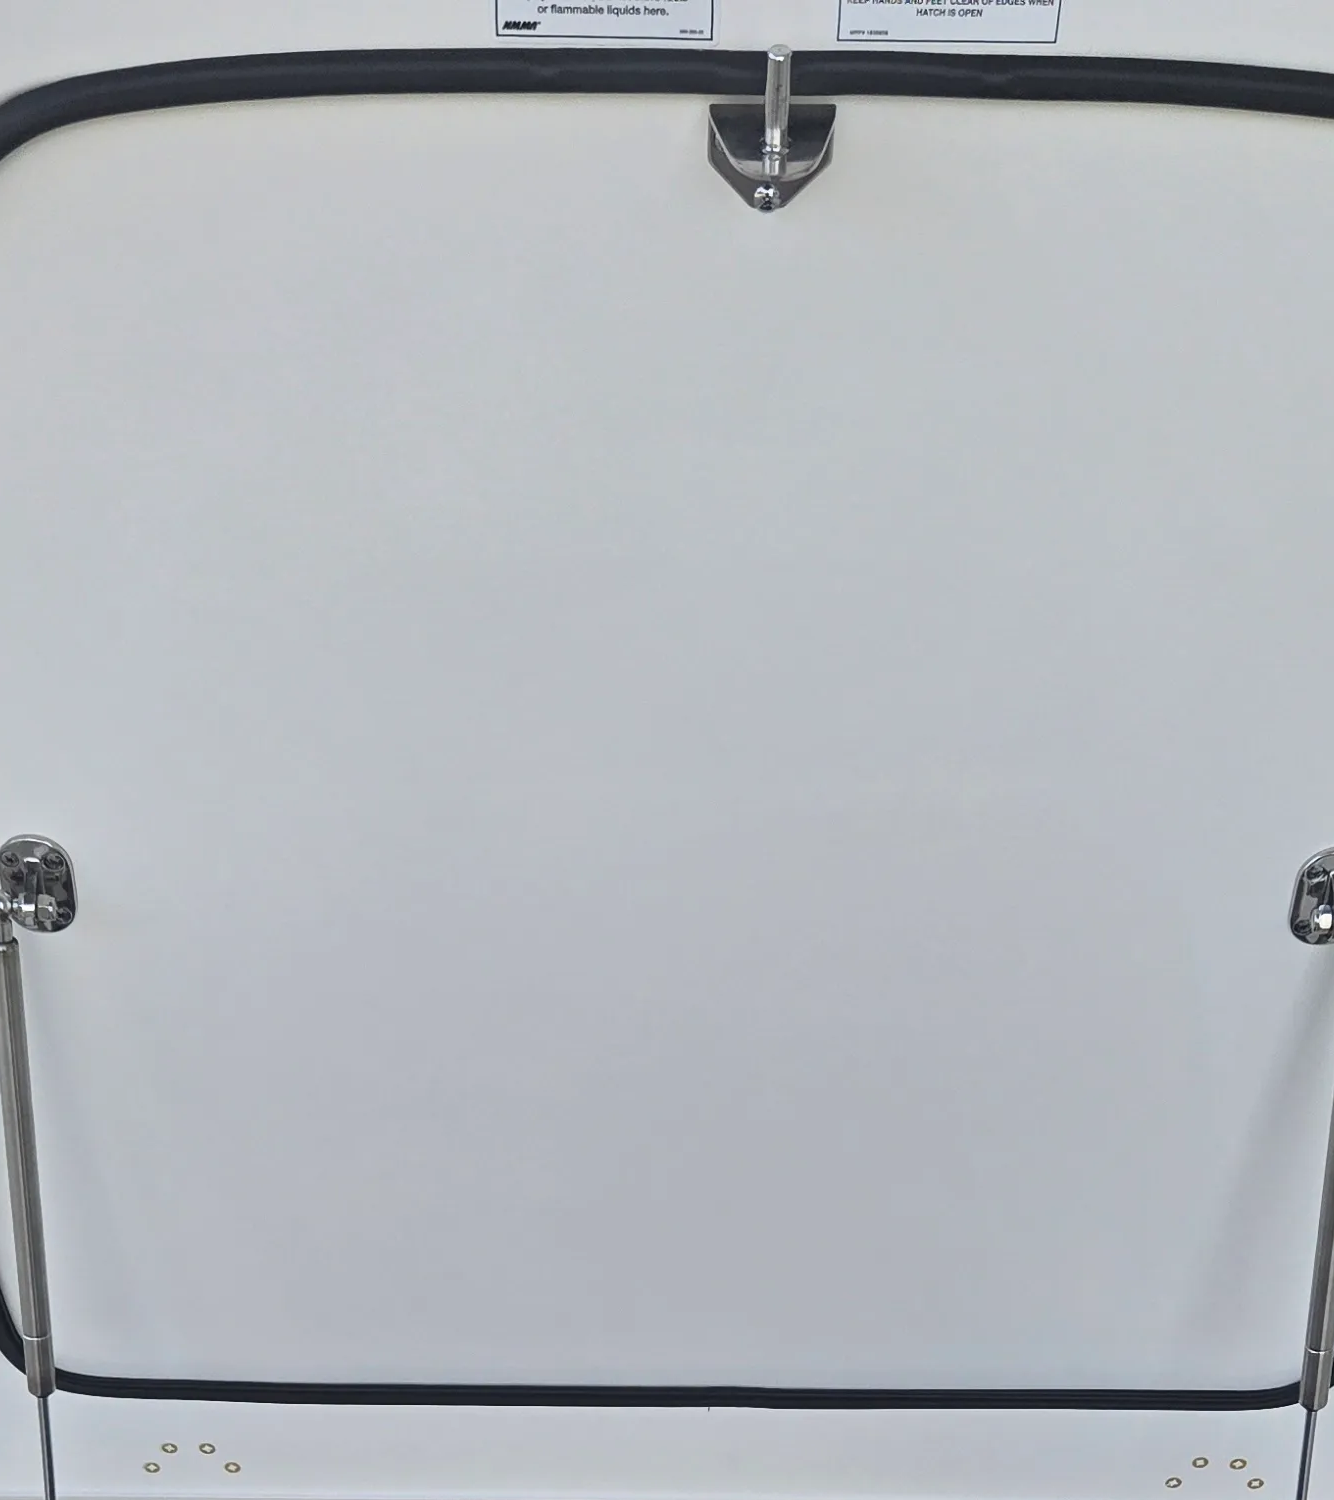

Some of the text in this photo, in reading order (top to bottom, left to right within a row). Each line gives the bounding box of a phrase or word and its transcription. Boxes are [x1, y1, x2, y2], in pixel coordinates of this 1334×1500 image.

[536, 4, 670, 17] or flammable liquids here.
[915, 8, 984, 17] HATCH IS OPEN
